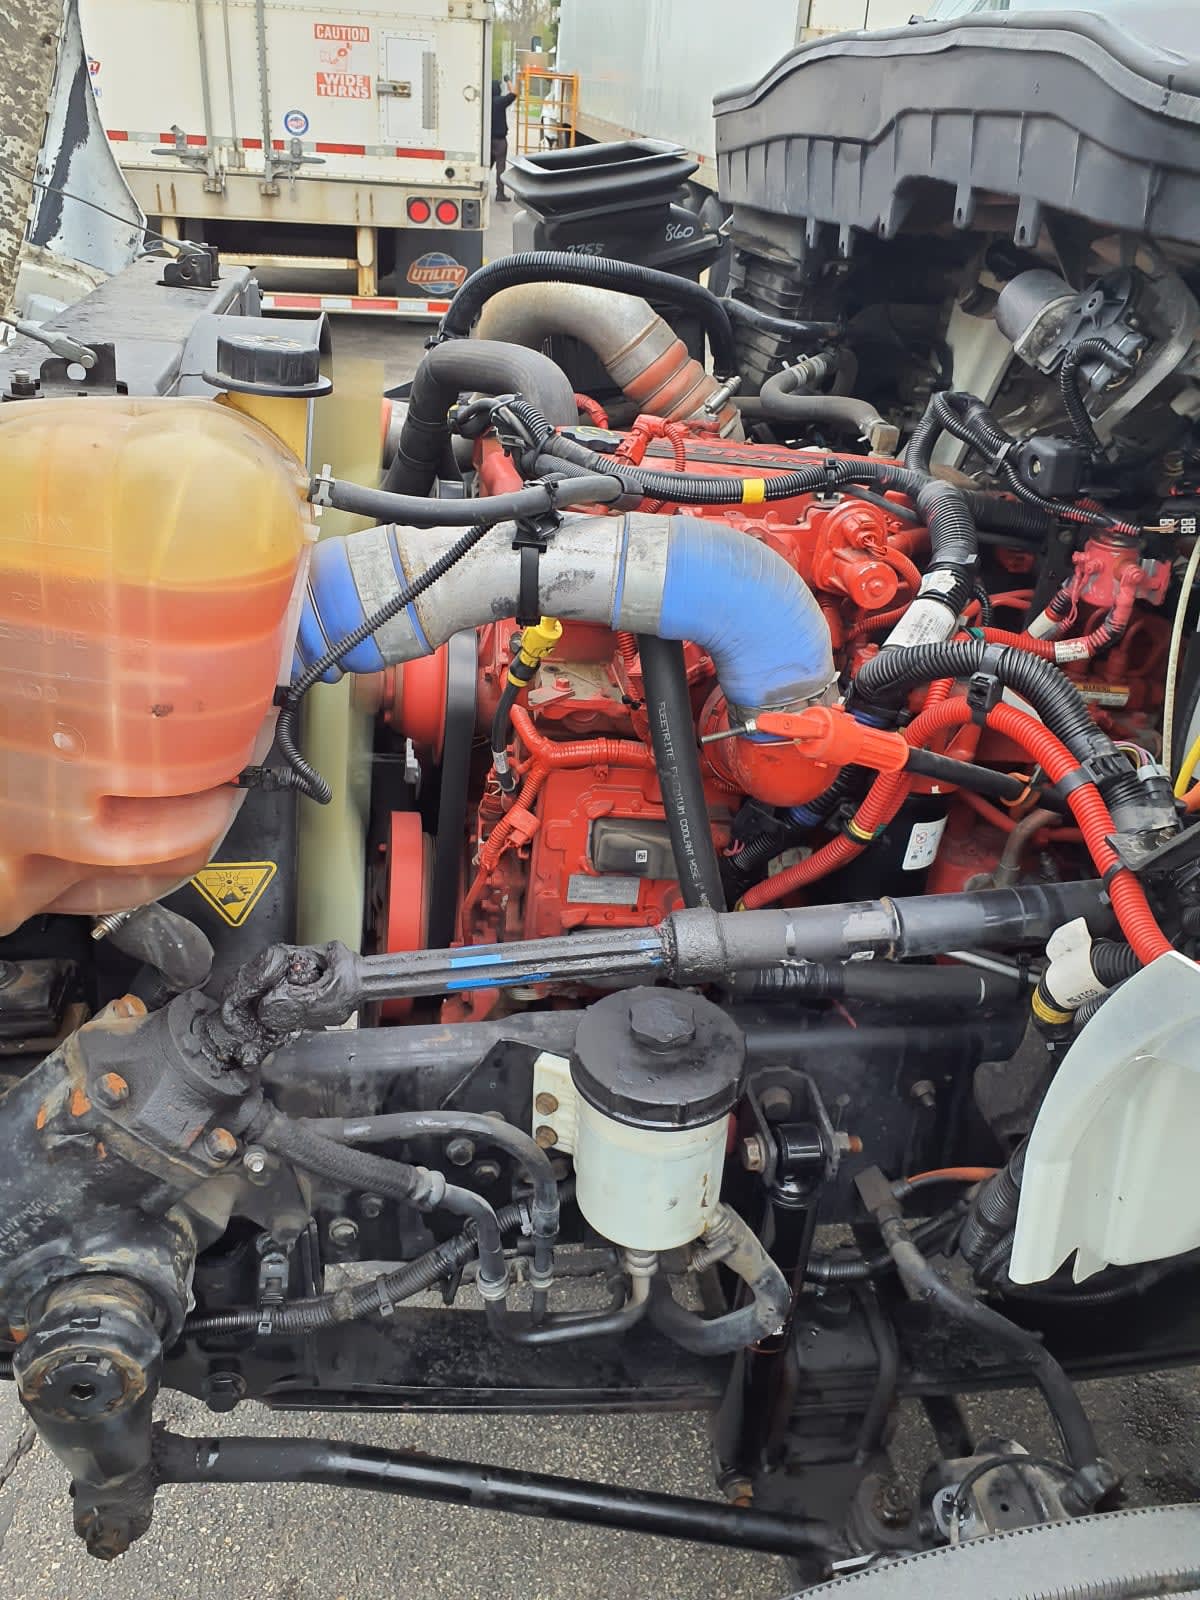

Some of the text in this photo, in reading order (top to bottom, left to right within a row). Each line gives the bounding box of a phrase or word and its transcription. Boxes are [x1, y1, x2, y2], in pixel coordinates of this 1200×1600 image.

[316, 25, 368, 41] CAUTION
[323, 74, 365, 86] WIDE
[318, 84, 369, 98] TURNS
[665, 223, 694, 241] 860
[411, 268, 465, 281] UTILITY
[659, 701, 676, 760] FLEETRITE
[680, 818, 695, 856] COOLANT
